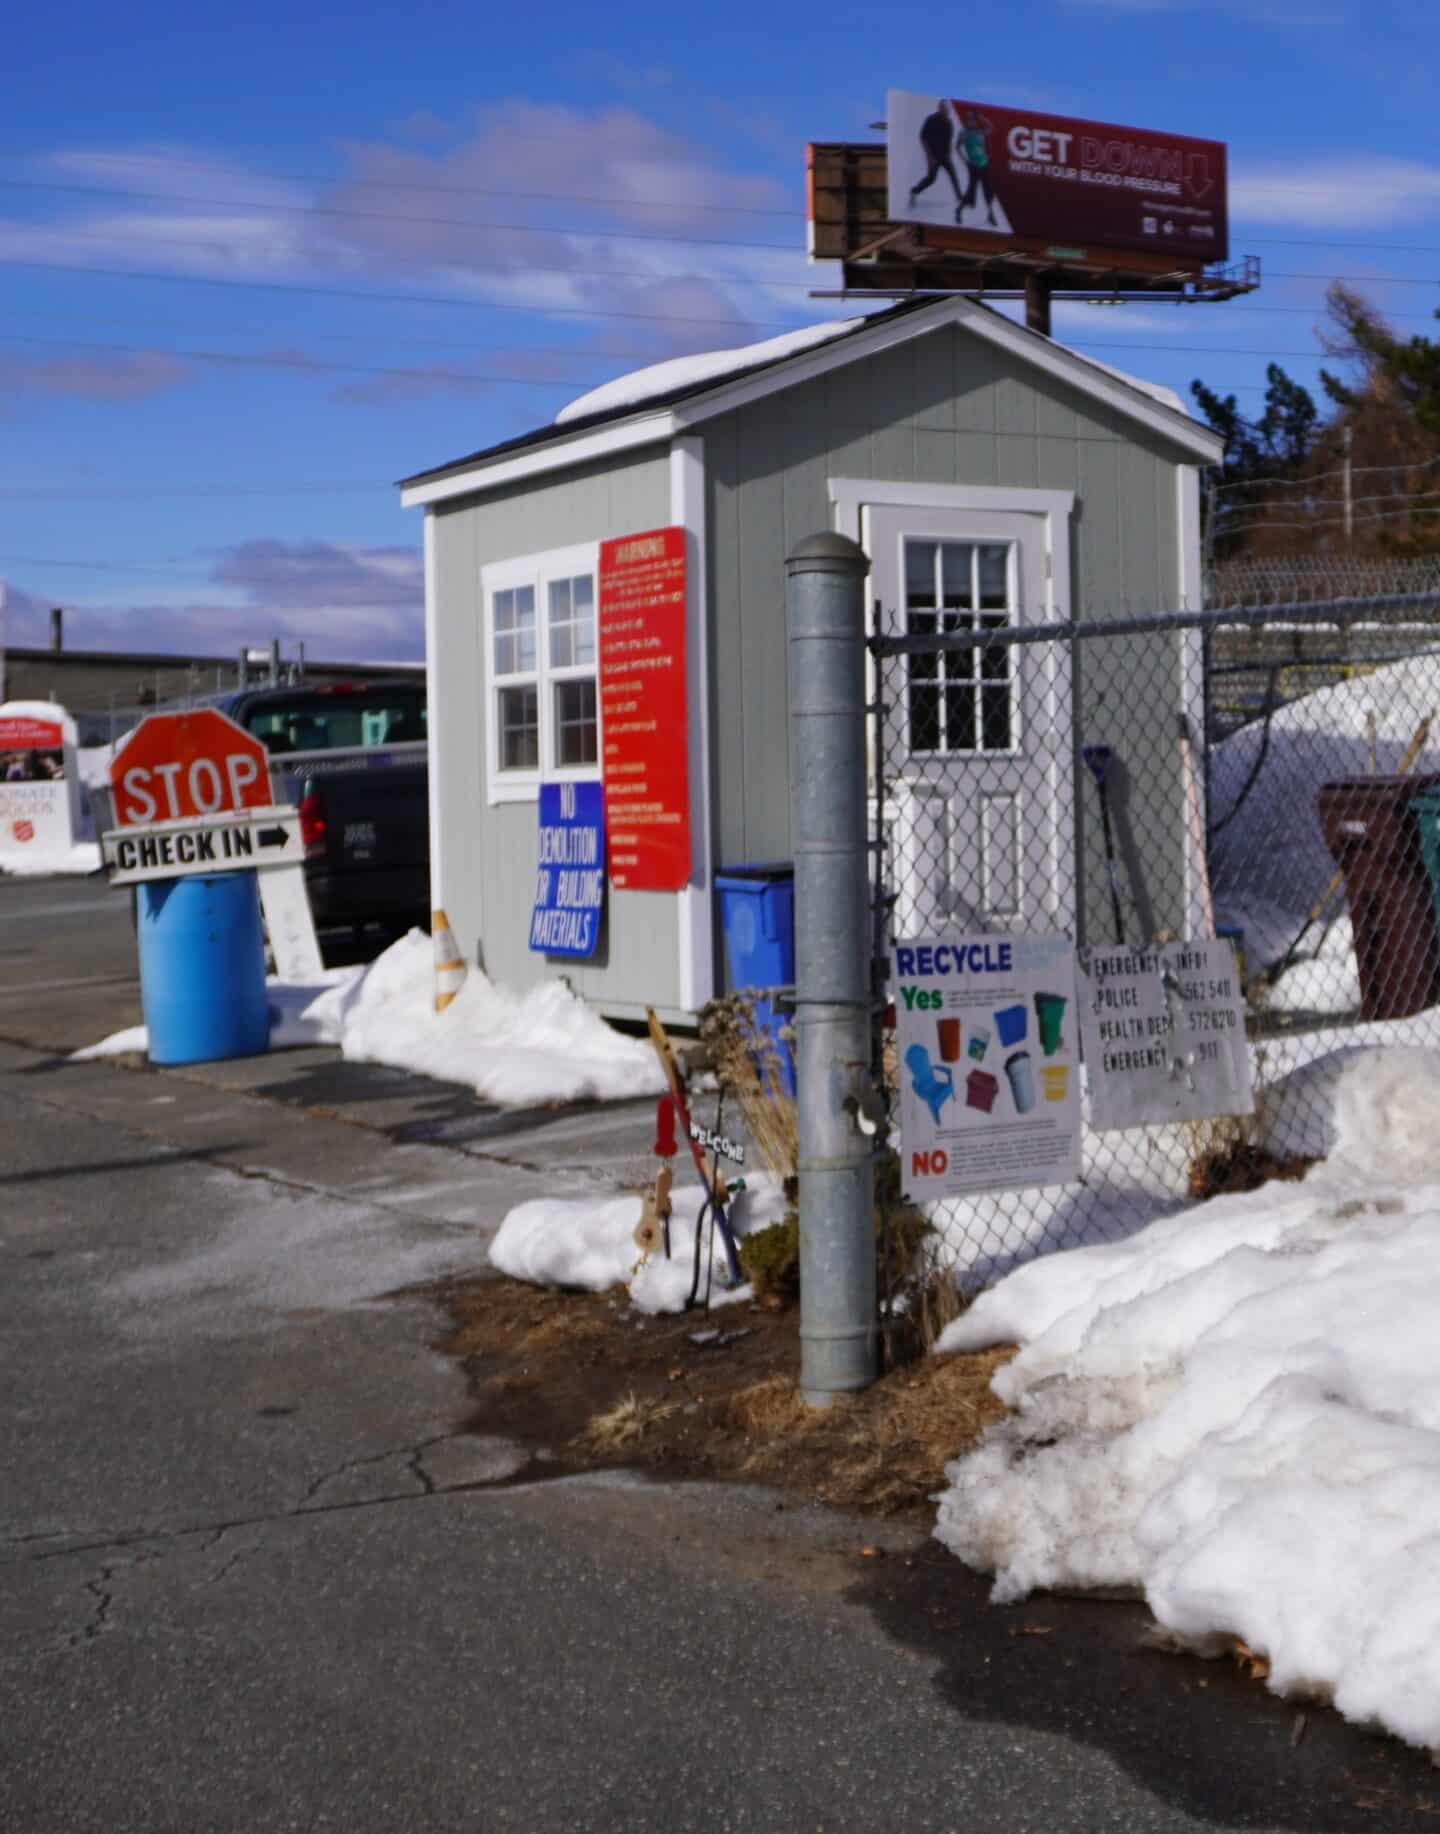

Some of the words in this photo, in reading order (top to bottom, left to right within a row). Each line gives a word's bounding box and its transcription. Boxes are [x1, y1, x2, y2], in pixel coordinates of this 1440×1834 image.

[1007, 125, 1072, 163] GET
[1080, 136, 1183, 179] DOWN
[1009, 160, 1041, 174] WITH
[1044, 165, 1077, 179] YOUR
[1080, 170, 1122, 186] BLOOD
[1124, 176, 1182, 195] PRESSURE
[124, 754, 258, 824] STOP
[560, 783, 575, 819] NO
[117, 830, 216, 869] CHECK
[223, 828, 252, 857] IN
[539, 827, 596, 864] DEMOLITION
[536, 869, 549, 906] OR
[556, 868, 602, 907] BUILDING
[531, 909, 591, 949] MATERIALS
[896, 943, 1012, 976] RECYCLE
[1094, 954, 1159, 977] EMERGENCY
[900, 985, 943, 1011] Yes
[1097, 987, 1138, 1009] POLICE
[1100, 1017, 1143, 1040] HEALTH
[1104, 1048, 1166, 1072] EMERGENCY
[691, 1121, 744, 1160] WELCOME
[912, 1150, 947, 1177] NO
